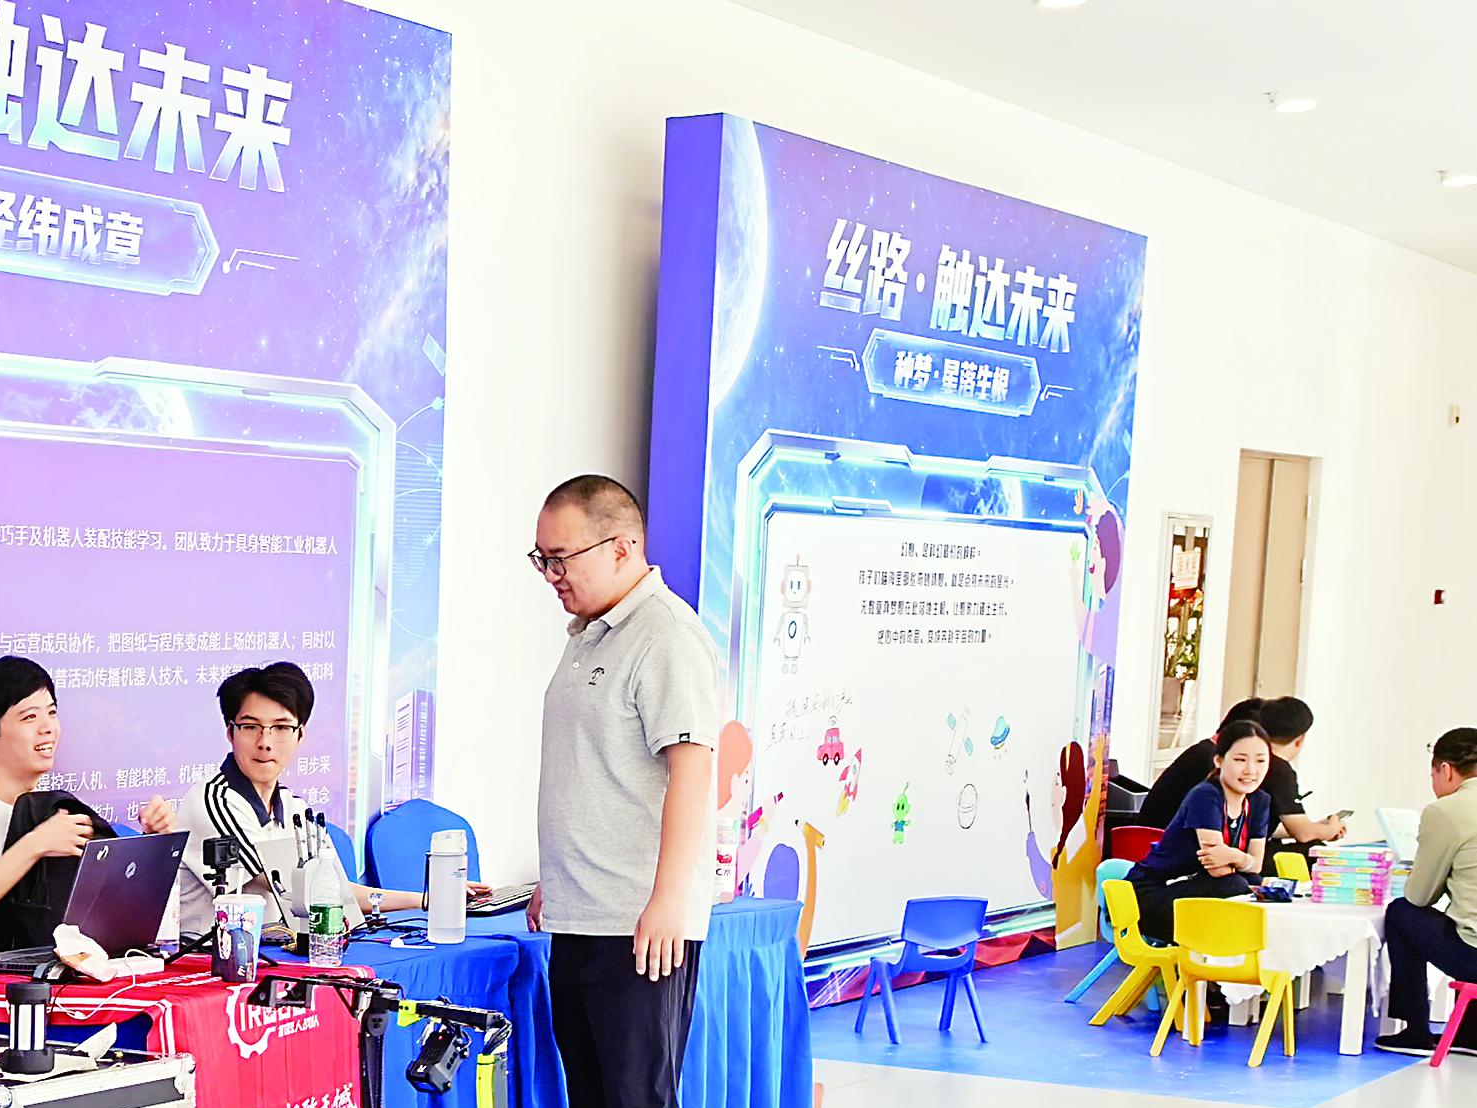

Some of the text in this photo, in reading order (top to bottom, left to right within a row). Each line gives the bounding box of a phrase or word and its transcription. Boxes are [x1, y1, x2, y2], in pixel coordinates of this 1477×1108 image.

[819, 218, 1078, 353] 丝路·触达未来
